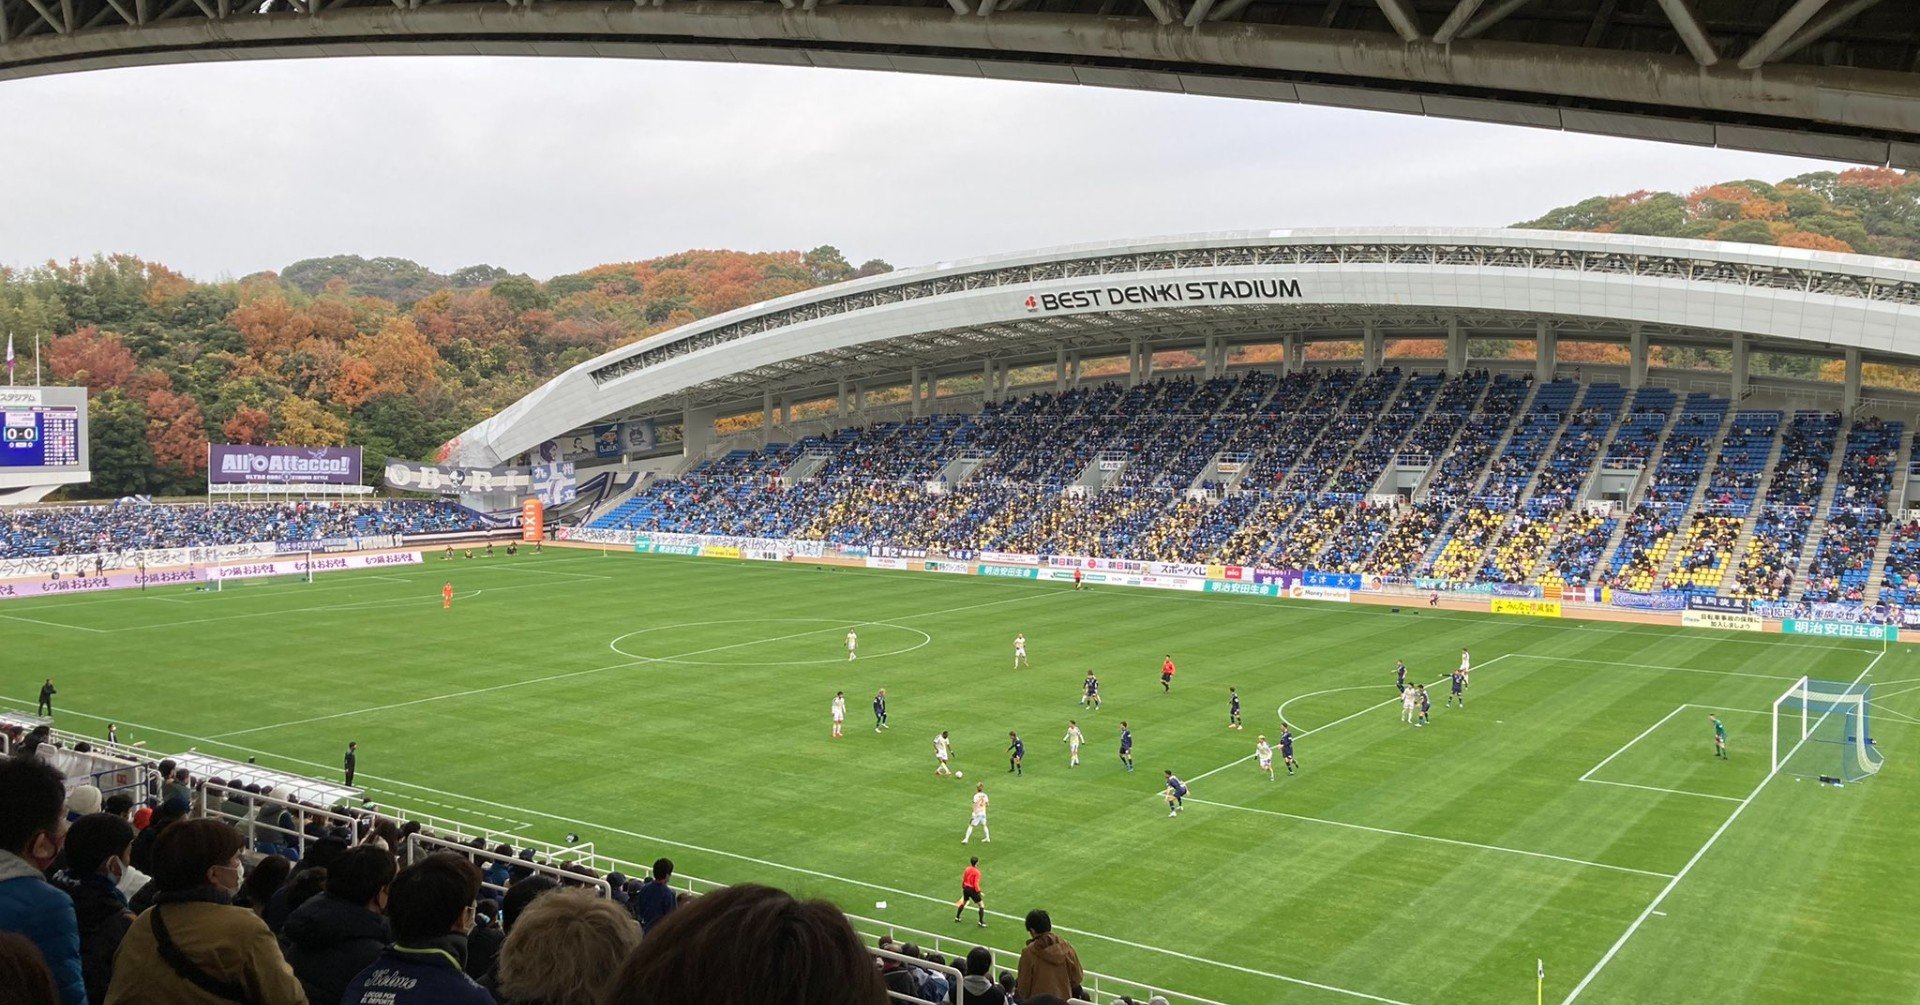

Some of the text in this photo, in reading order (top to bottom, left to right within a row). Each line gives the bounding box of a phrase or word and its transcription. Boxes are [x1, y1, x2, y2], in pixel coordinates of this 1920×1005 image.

[1041, 290, 1102, 311] BEST
[1186, 279, 1302, 299] STADIUM
[524, 503, 536, 538] LIXIL
[984, 566, 1031, 577] 明治安田生命
[1161, 565, 1207, 576] スポーツくじ
[1211, 582, 1270, 594] 明治安田生命
[1794, 621, 1884, 638] 明治安田生命
